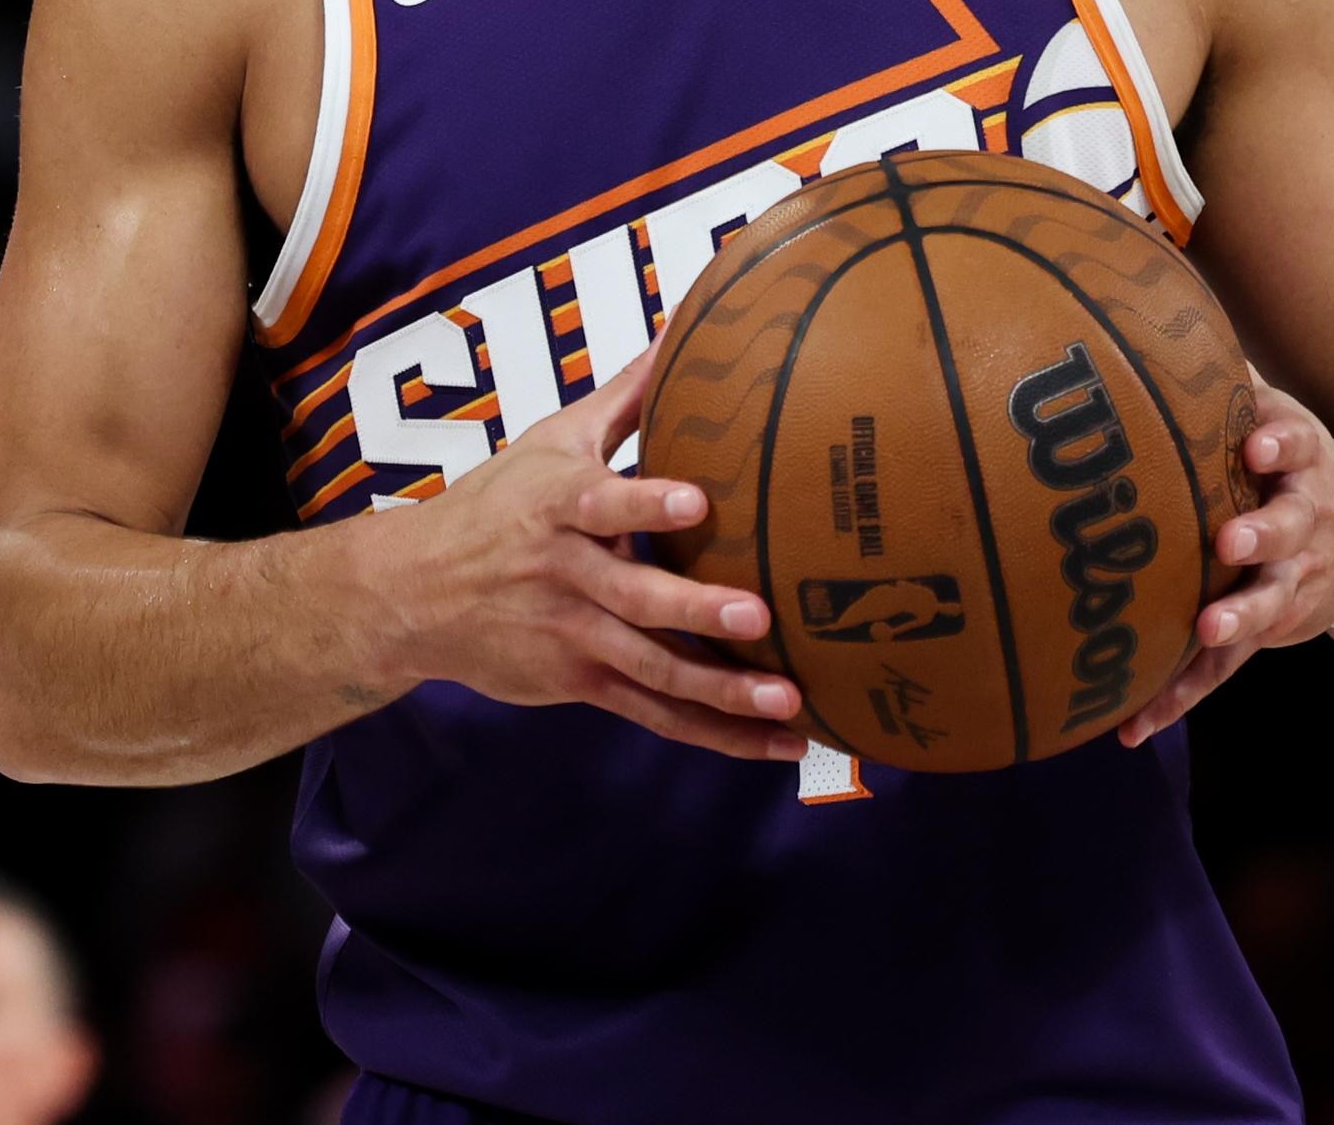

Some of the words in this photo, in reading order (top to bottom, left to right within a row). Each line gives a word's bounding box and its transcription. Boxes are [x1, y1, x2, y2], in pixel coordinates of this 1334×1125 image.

[852, 416, 877, 479] OFFICIAL
[854, 481, 880, 520] GAME
[858, 524, 884, 558] BALL
[1006, 340, 1158, 734] Wilson
